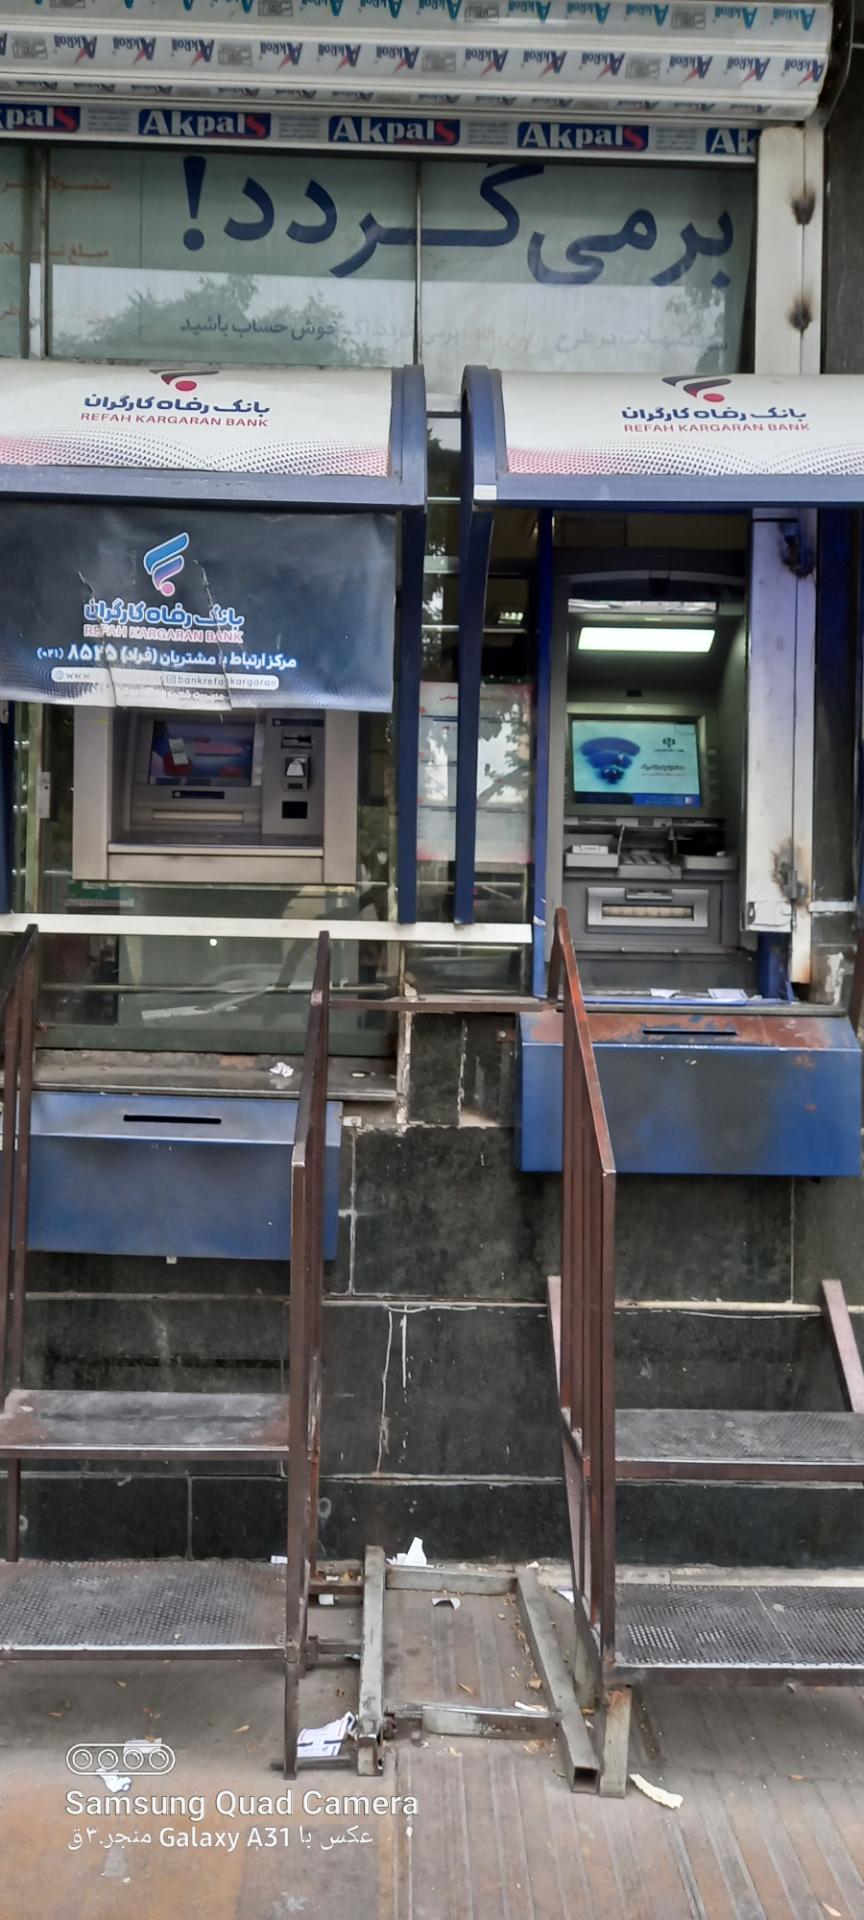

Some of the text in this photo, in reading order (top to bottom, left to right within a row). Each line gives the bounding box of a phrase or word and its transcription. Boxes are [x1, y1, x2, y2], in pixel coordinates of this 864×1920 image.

[179, 314, 228, 338] باشید
[232, 318, 288, 338] حساب
[83, 393, 270, 415] بانک رفاه کارگران
[80, 412, 269, 428] REFAH KARGARAN BANK
[621, 405, 807, 423] بانک رفاه کارگران
[623, 422, 811, 433] REFAH KARGARAN BANK
[83, 598, 244, 629] بانک رفاه کارگران
[83, 624, 244, 644] REFAH KARGARAN BANK
[159, 649, 216, 668] مشتریان
[228, 649, 265, 668] ارتباط
[266, 652, 297, 669] مرکز
